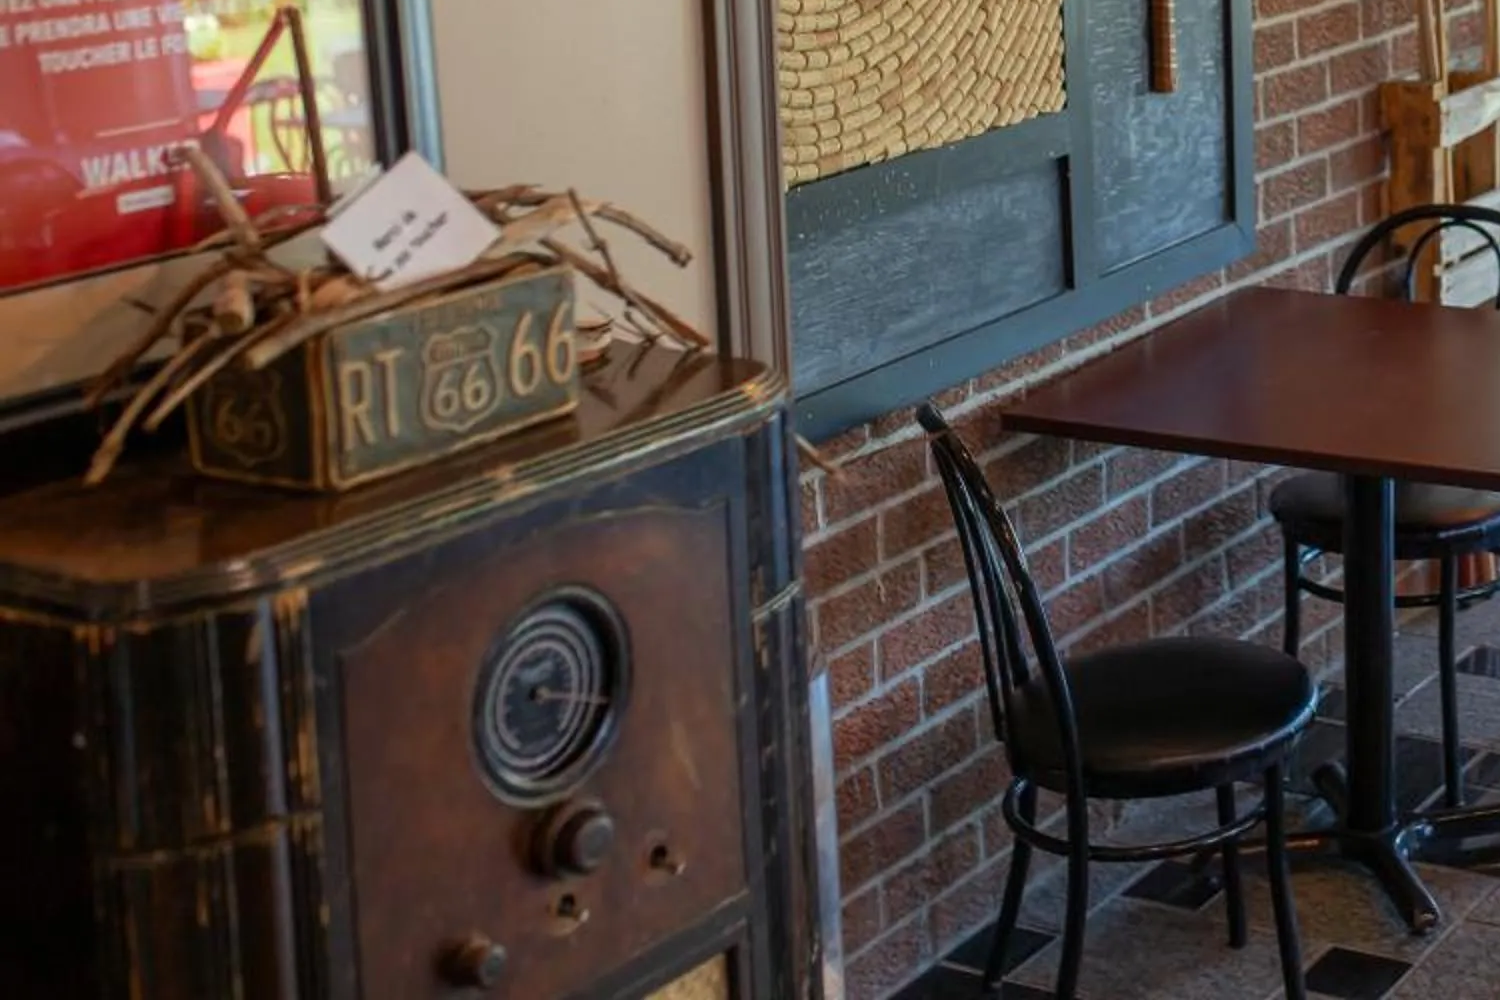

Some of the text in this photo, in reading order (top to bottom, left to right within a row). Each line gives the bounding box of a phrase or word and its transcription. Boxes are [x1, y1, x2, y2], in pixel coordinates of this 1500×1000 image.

[15, 13, 112, 44] PRENDRA
[38, 41, 131, 74] TOUCHER
[134, 37, 157, 60] LE
[338, 301, 577, 452] RT 66 66
